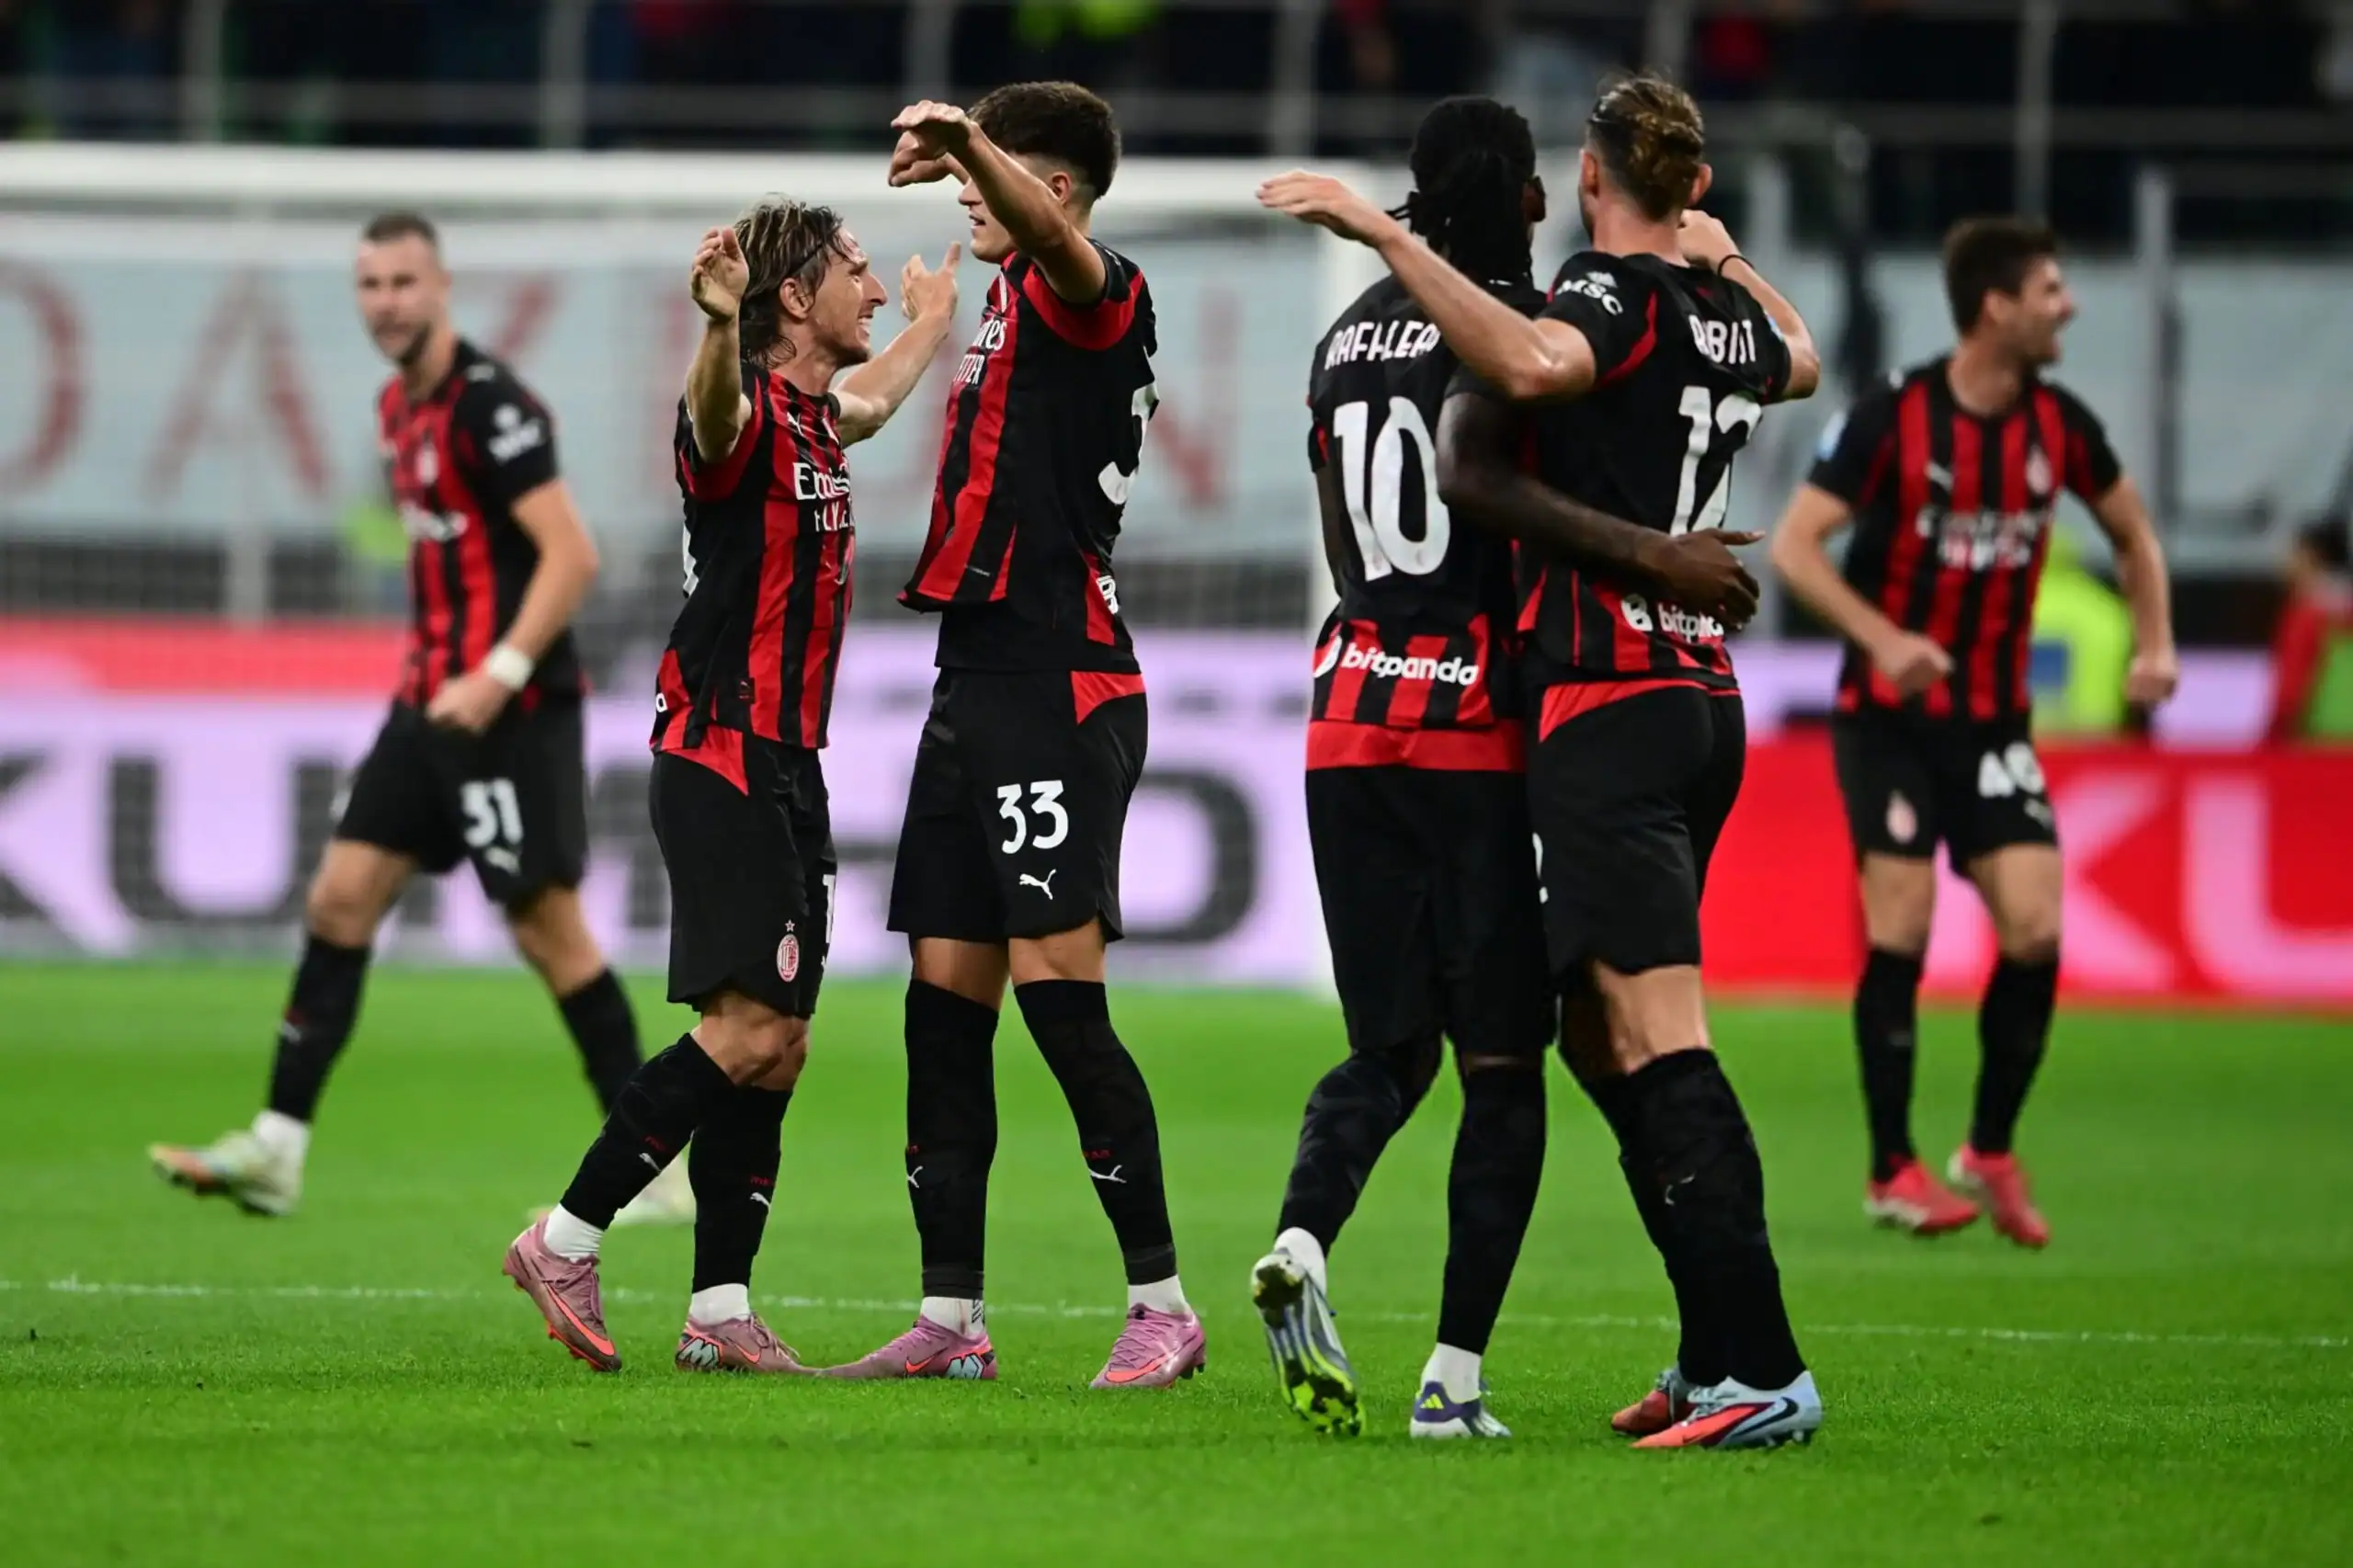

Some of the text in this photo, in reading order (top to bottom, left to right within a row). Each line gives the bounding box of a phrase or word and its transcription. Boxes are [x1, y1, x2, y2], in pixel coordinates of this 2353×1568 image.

[1554, 278, 1624, 316] MSC
[1333, 395, 1451, 583] 10
[1668, 384, 1762, 539] 12
[1340, 642, 1480, 687] bitpanda
[460, 778, 524, 847] 31
[996, 779, 1069, 854] 33
